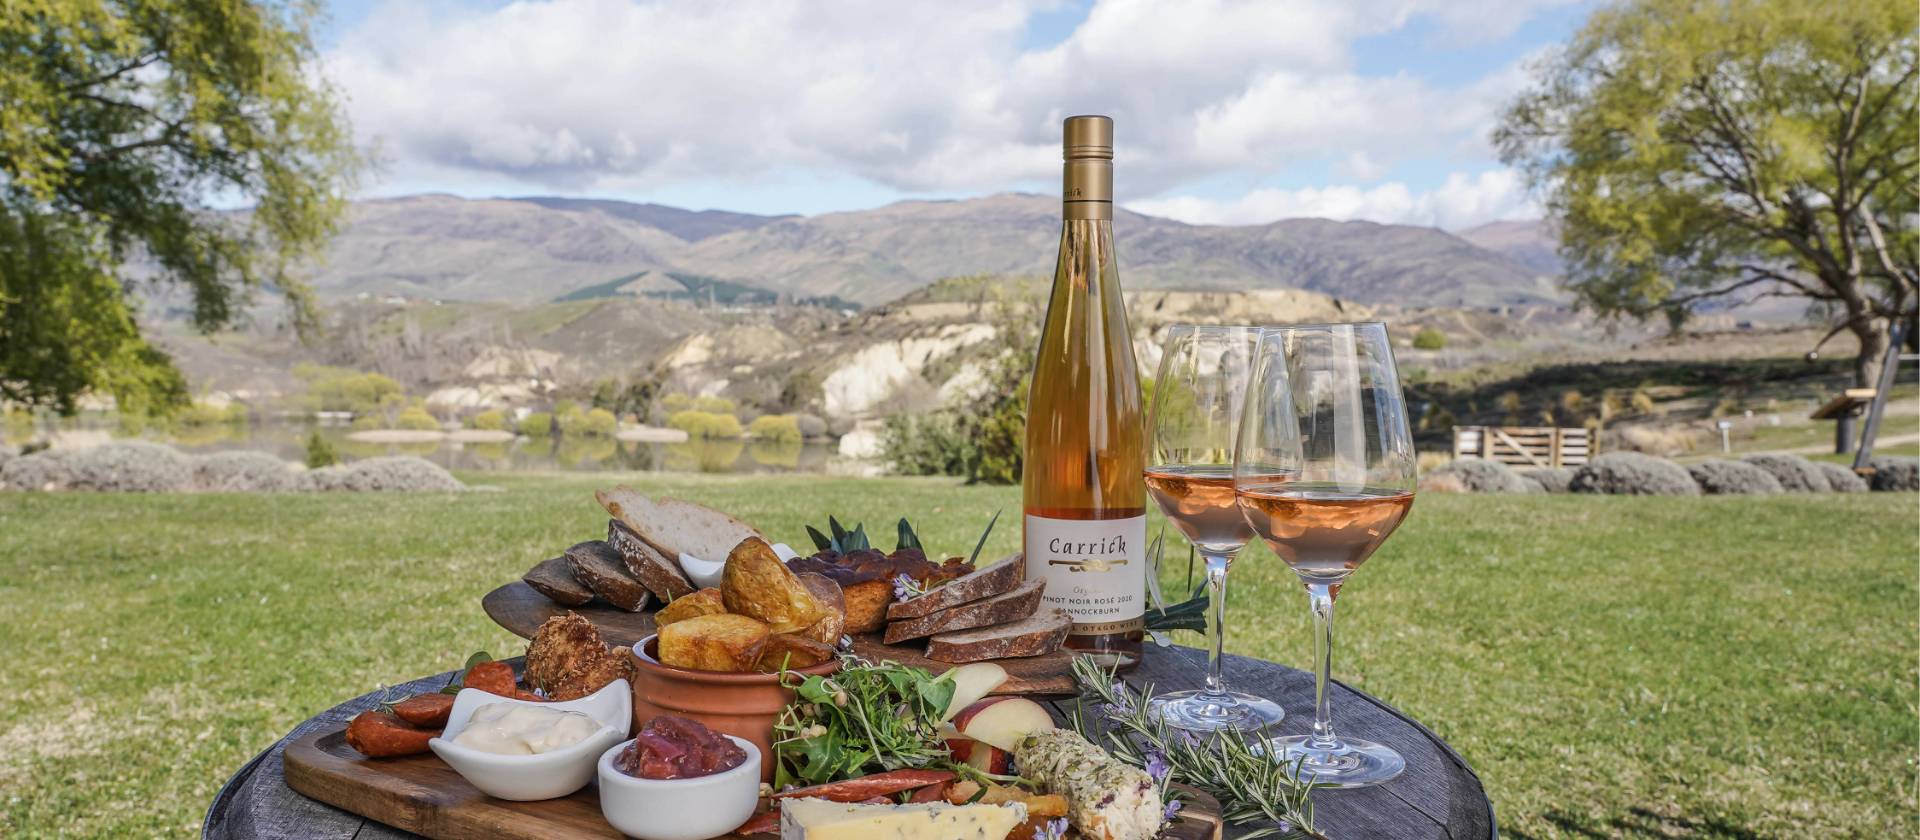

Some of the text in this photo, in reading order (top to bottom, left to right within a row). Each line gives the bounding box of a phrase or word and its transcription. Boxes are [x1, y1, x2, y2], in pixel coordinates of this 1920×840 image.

[1049, 535, 1126, 555] Carrick
[1042, 595, 1066, 604] PINOT
[1062, 607, 1120, 616] ANNOCKBURN
[1082, 624, 1116, 632] OTAGO
